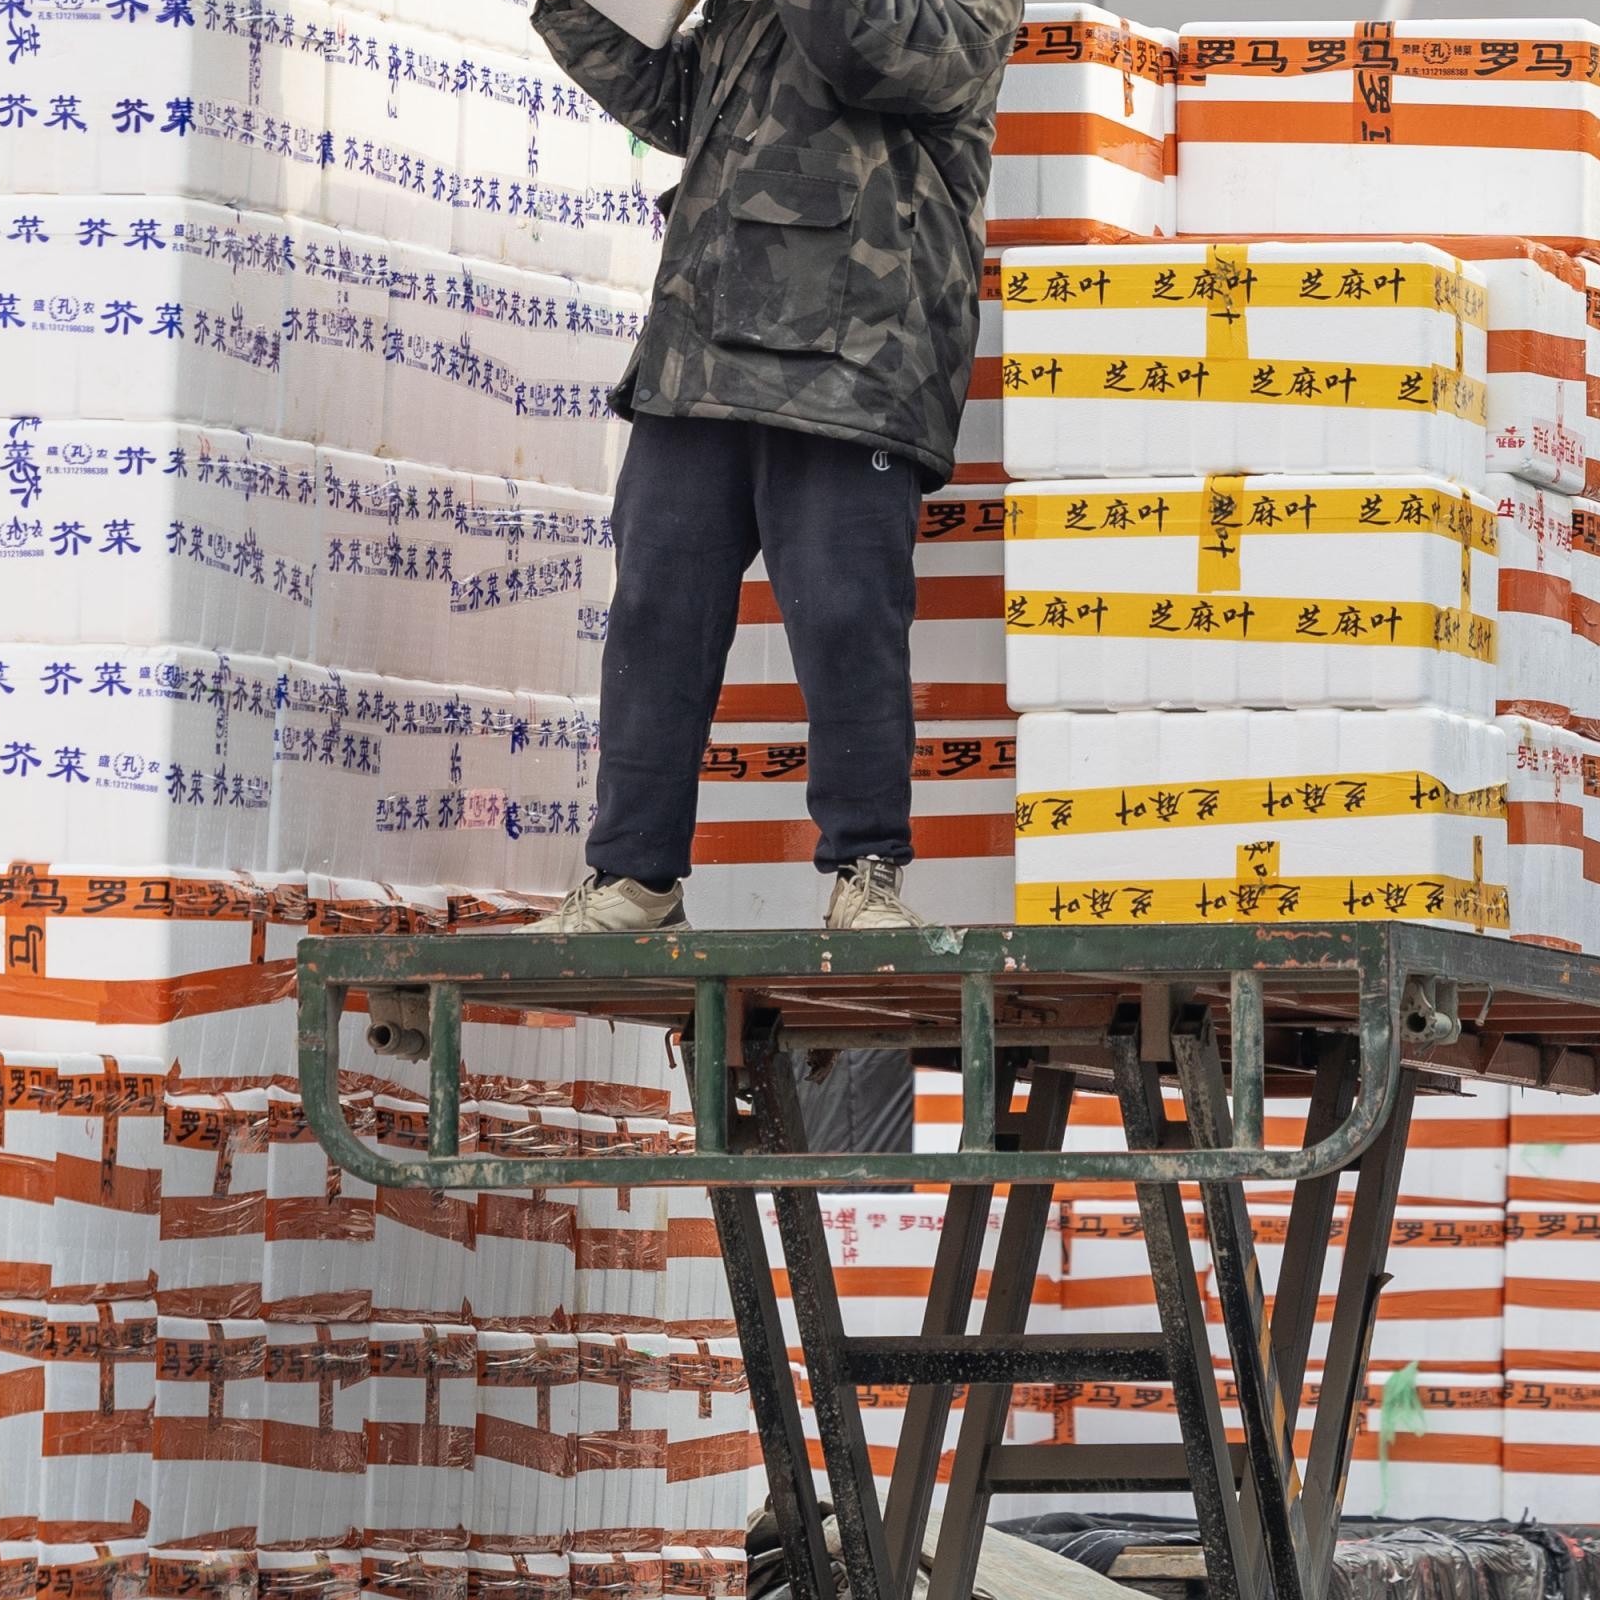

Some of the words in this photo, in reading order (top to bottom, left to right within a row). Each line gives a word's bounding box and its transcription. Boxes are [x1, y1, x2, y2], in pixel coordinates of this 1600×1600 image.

[1196, 39, 1288, 74] 罗马
[1301, 34, 1399, 76] 罗马
[1477, 42, 1573, 78] 罗马
[79, 217, 167, 251] 芥菜
[1006, 269, 1111, 305] 芝麻叶
[1299, 267, 1406, 303] 芝麻叶
[99, 299, 184, 338] 芥菜
[1103, 359, 1210, 398] 芝麻叶
[1250, 364, 1357, 403] 芝麻叶
[1064, 497, 1170, 532] 芝麻叶
[1210, 493, 1317, 533] 芝麻叶
[49, 519, 142, 557] 芥菜
[1006, 596, 1109, 633] 芝麻叶
[1148, 599, 1255, 638] 芝麻叶
[1295, 604, 1403, 642] 芝麻叶
[44, 661, 133, 697] 芥菜
[0, 741, 90, 784] 芥菜
[1115, 788, 1220, 826] 芝麻叶
[1261, 780, 1368, 817] 芝麻叶
[82, 879, 175, 917] 罗马
[1049, 886, 1154, 921] 芝麻叶
